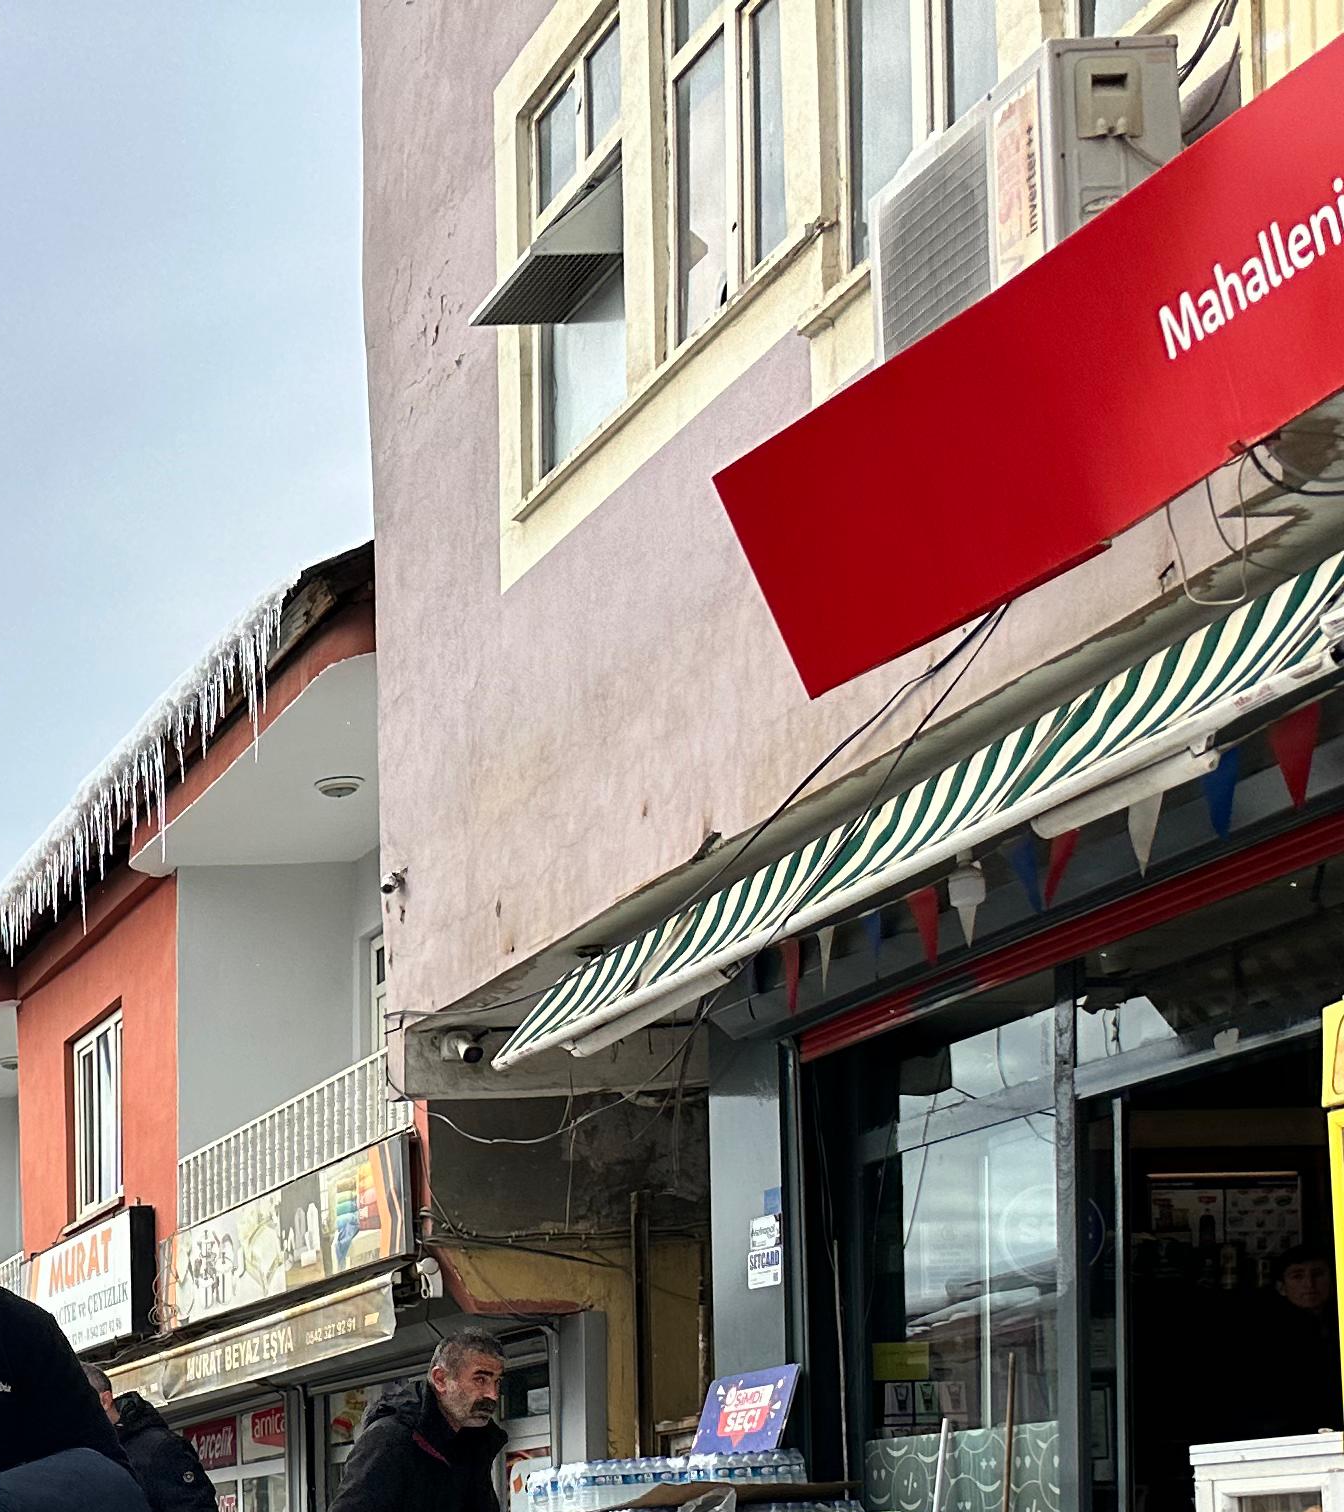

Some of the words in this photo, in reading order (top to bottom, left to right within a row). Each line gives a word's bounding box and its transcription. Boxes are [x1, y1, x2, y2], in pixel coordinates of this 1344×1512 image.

[49, 1227, 112, 1297] MURAT
[186, 1348, 222, 1382] MURAT
[225, 1336, 260, 1371] BEYAZ
[262, 1326, 294, 1364] EŞYA
[198, 1426, 234, 1464] arçelik
